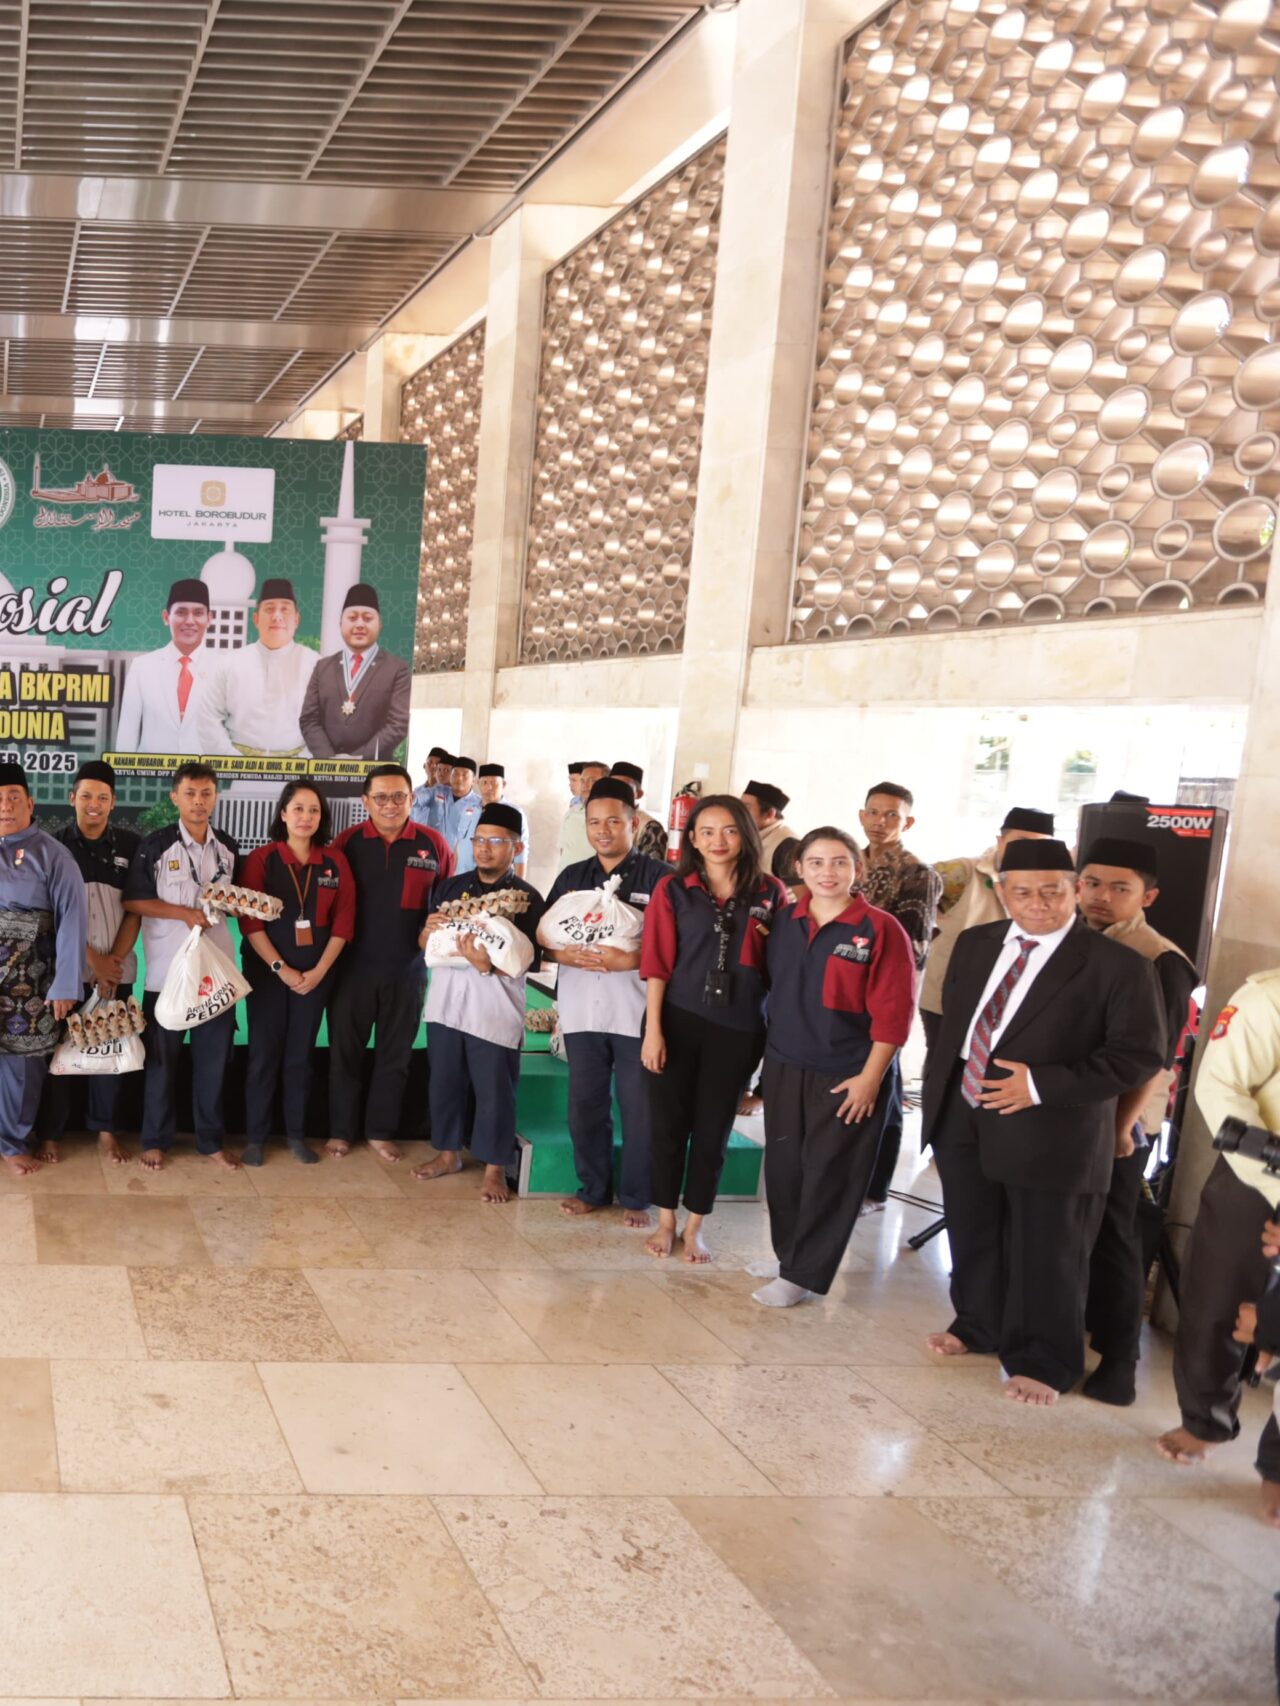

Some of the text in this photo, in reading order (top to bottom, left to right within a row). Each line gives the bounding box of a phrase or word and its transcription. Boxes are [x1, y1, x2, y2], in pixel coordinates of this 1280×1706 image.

[158, 509, 267, 521] HOTEL BOROBUDUR
[20, 671, 111, 704] BKPRMI
[25, 753, 77, 772] 2025
[231, 760, 245, 769] SAID
[314, 762, 337, 772] DATUK
[339, 763, 362, 774] MOHD.
[136, 769, 157, 777] UMUM
[313, 775, 333, 783] KETUA
[1146, 815, 1213, 831] 2500W
